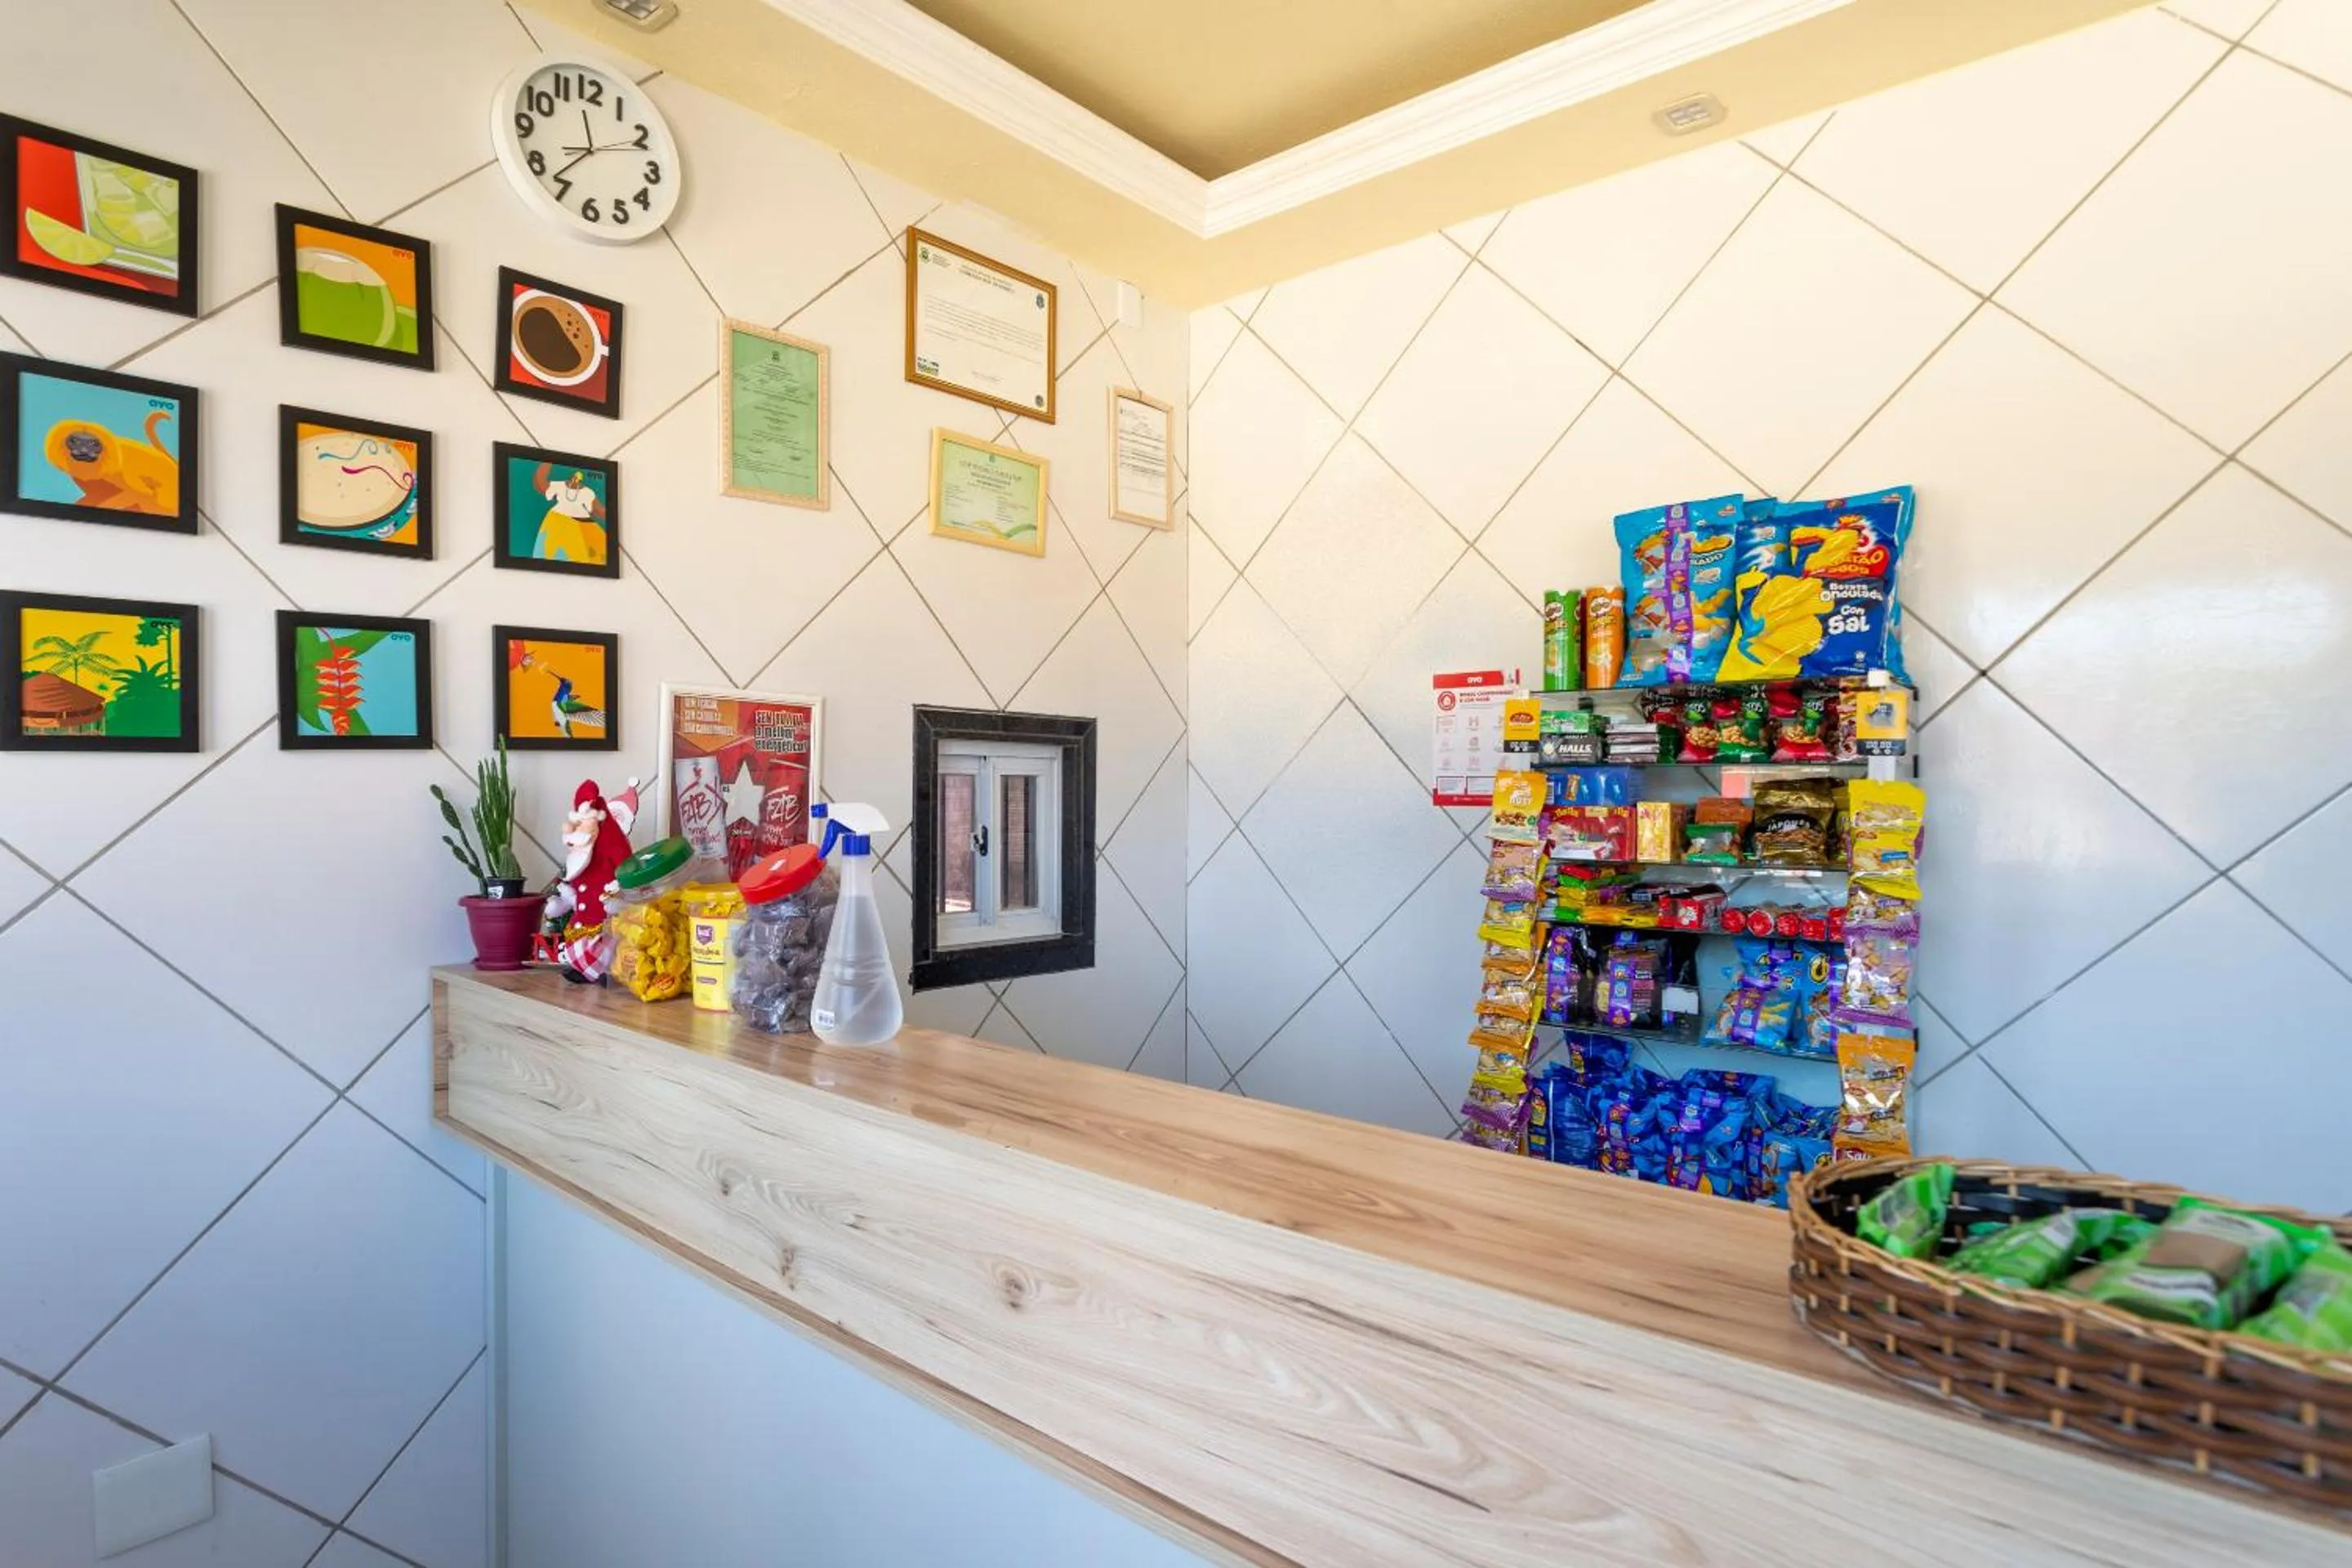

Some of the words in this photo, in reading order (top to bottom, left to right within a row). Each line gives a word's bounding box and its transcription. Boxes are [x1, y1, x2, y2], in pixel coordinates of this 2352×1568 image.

[555, 72, 570, 102] 11
[578, 74, 603, 107] 12
[527, 86, 555, 118] 10
[616, 96, 623, 122] 1
[515, 113, 534, 138] 9
[632, 124, 649, 150] 2
[527, 150, 546, 176] 8
[644, 160, 661, 185] 3
[553, 176, 572, 202] 7
[633, 187, 651, 212] 4
[581, 198, 599, 223] 6
[612, 198, 630, 225] 5
[149, 399, 174, 410] OYO
[390, 633, 412, 641] OYO
[1558, 744, 1592, 753] HALLS
